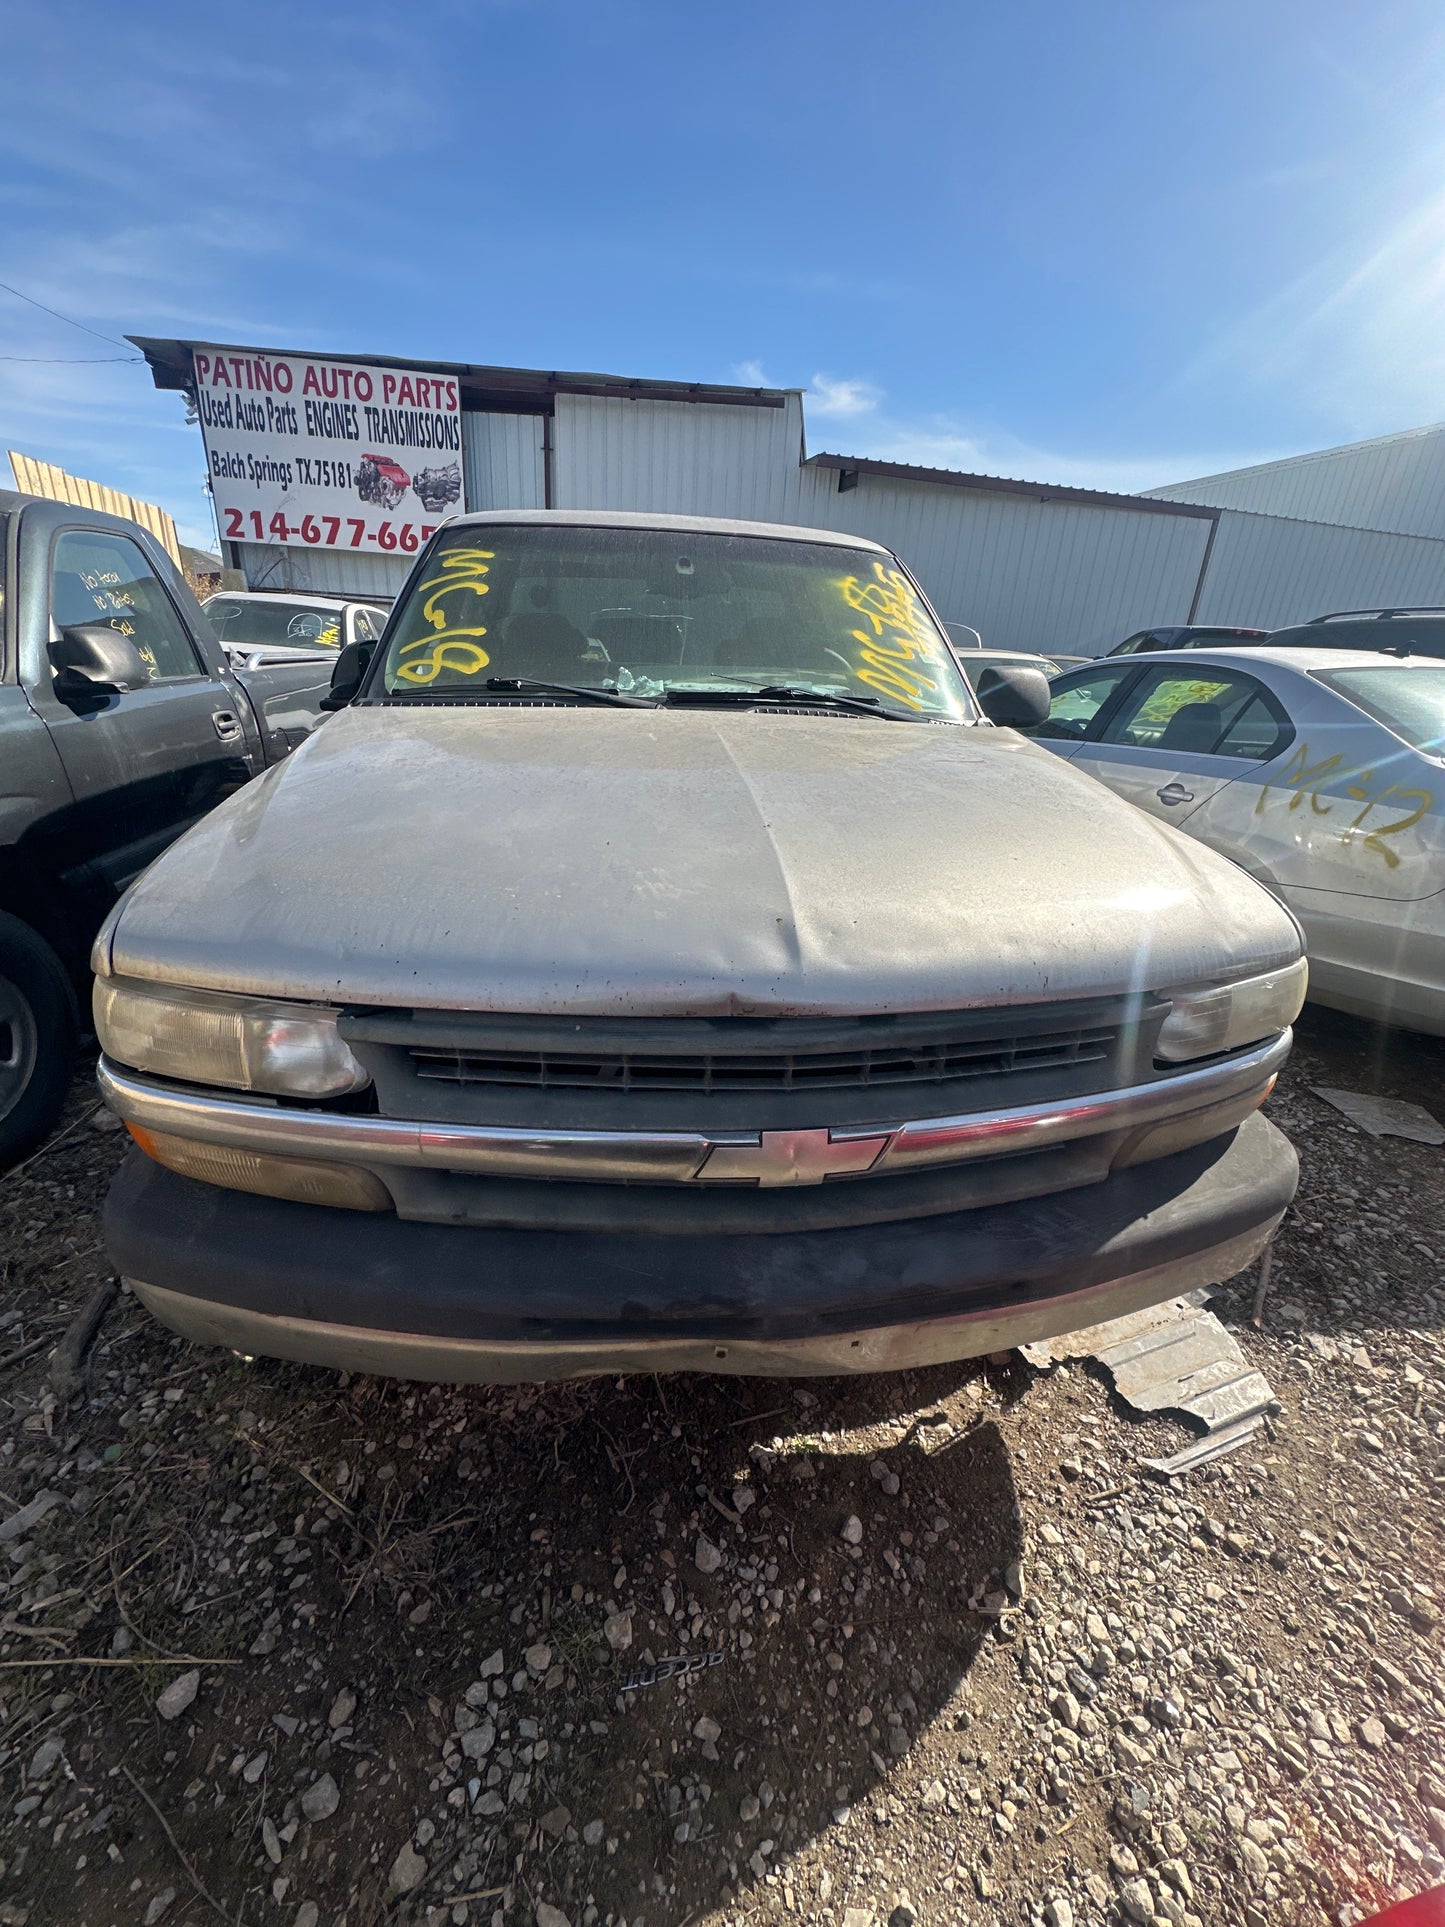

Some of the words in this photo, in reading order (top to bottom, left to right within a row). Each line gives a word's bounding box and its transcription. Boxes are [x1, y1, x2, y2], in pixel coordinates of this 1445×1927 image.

[196, 354, 293, 394] PATIÑO
[303, 366, 373, 402] AUTO
[383, 374, 457, 411] PARTS
[201, 390, 232, 427] Used
[236, 393, 266, 432] Auto
[266, 396, 298, 435] Parts
[304, 400, 359, 441] ENGINES
[364, 406, 460, 451] TRANSMISSIONS
[211, 450, 246, 480] Balch
[249, 452, 293, 491] Springs
[295, 457, 352, 489] TX.75181
